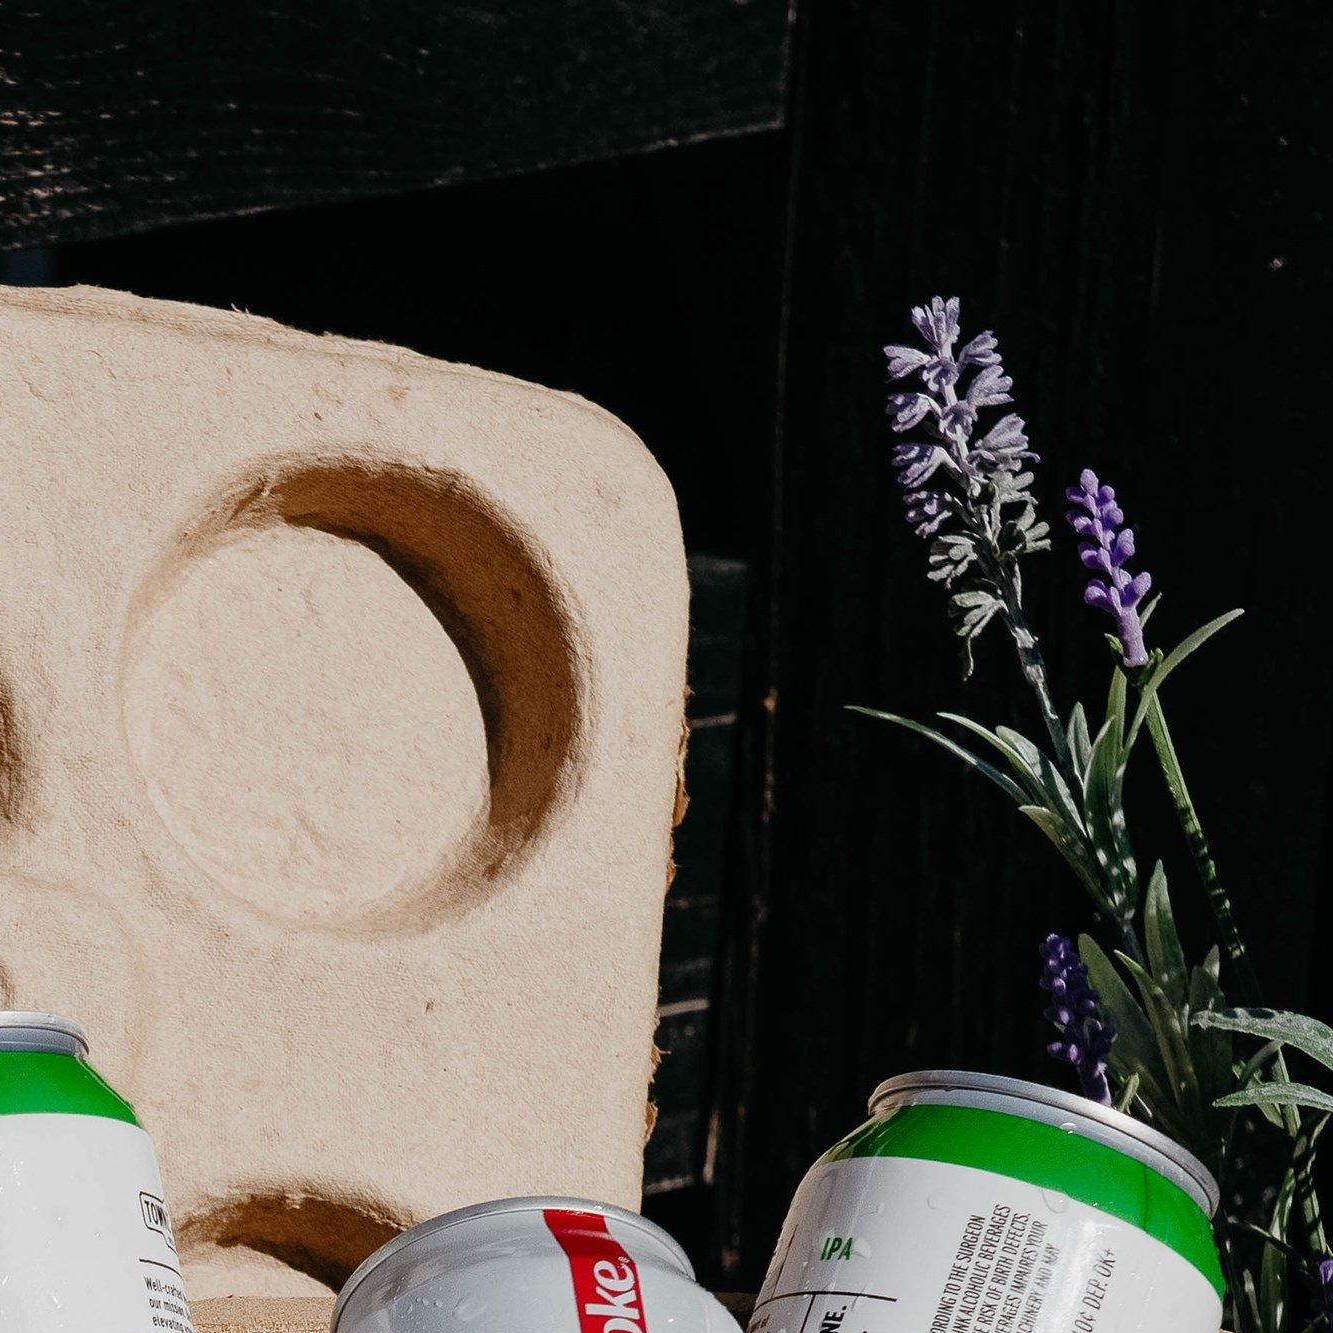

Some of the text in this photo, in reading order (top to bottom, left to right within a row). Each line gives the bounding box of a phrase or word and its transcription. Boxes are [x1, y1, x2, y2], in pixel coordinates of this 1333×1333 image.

[954, 1212, 986, 1264] SURGEON
[1001, 1209, 1031, 1255] DEFECTS.
[1025, 1218, 1048, 1248] YOUR
[820, 1237, 853, 1261] IPA
[958, 1259, 990, 1317] ALCOHOLIC
[977, 1202, 1012, 1262] BEVERAGES
[948, 1260, 968, 1283] THE
[990, 1254, 1014, 1286] BIRTH
[943, 1280, 962, 1297] TO
[985, 1284, 1004, 1301] OF
[976, 1300, 998, 1326] RISK
